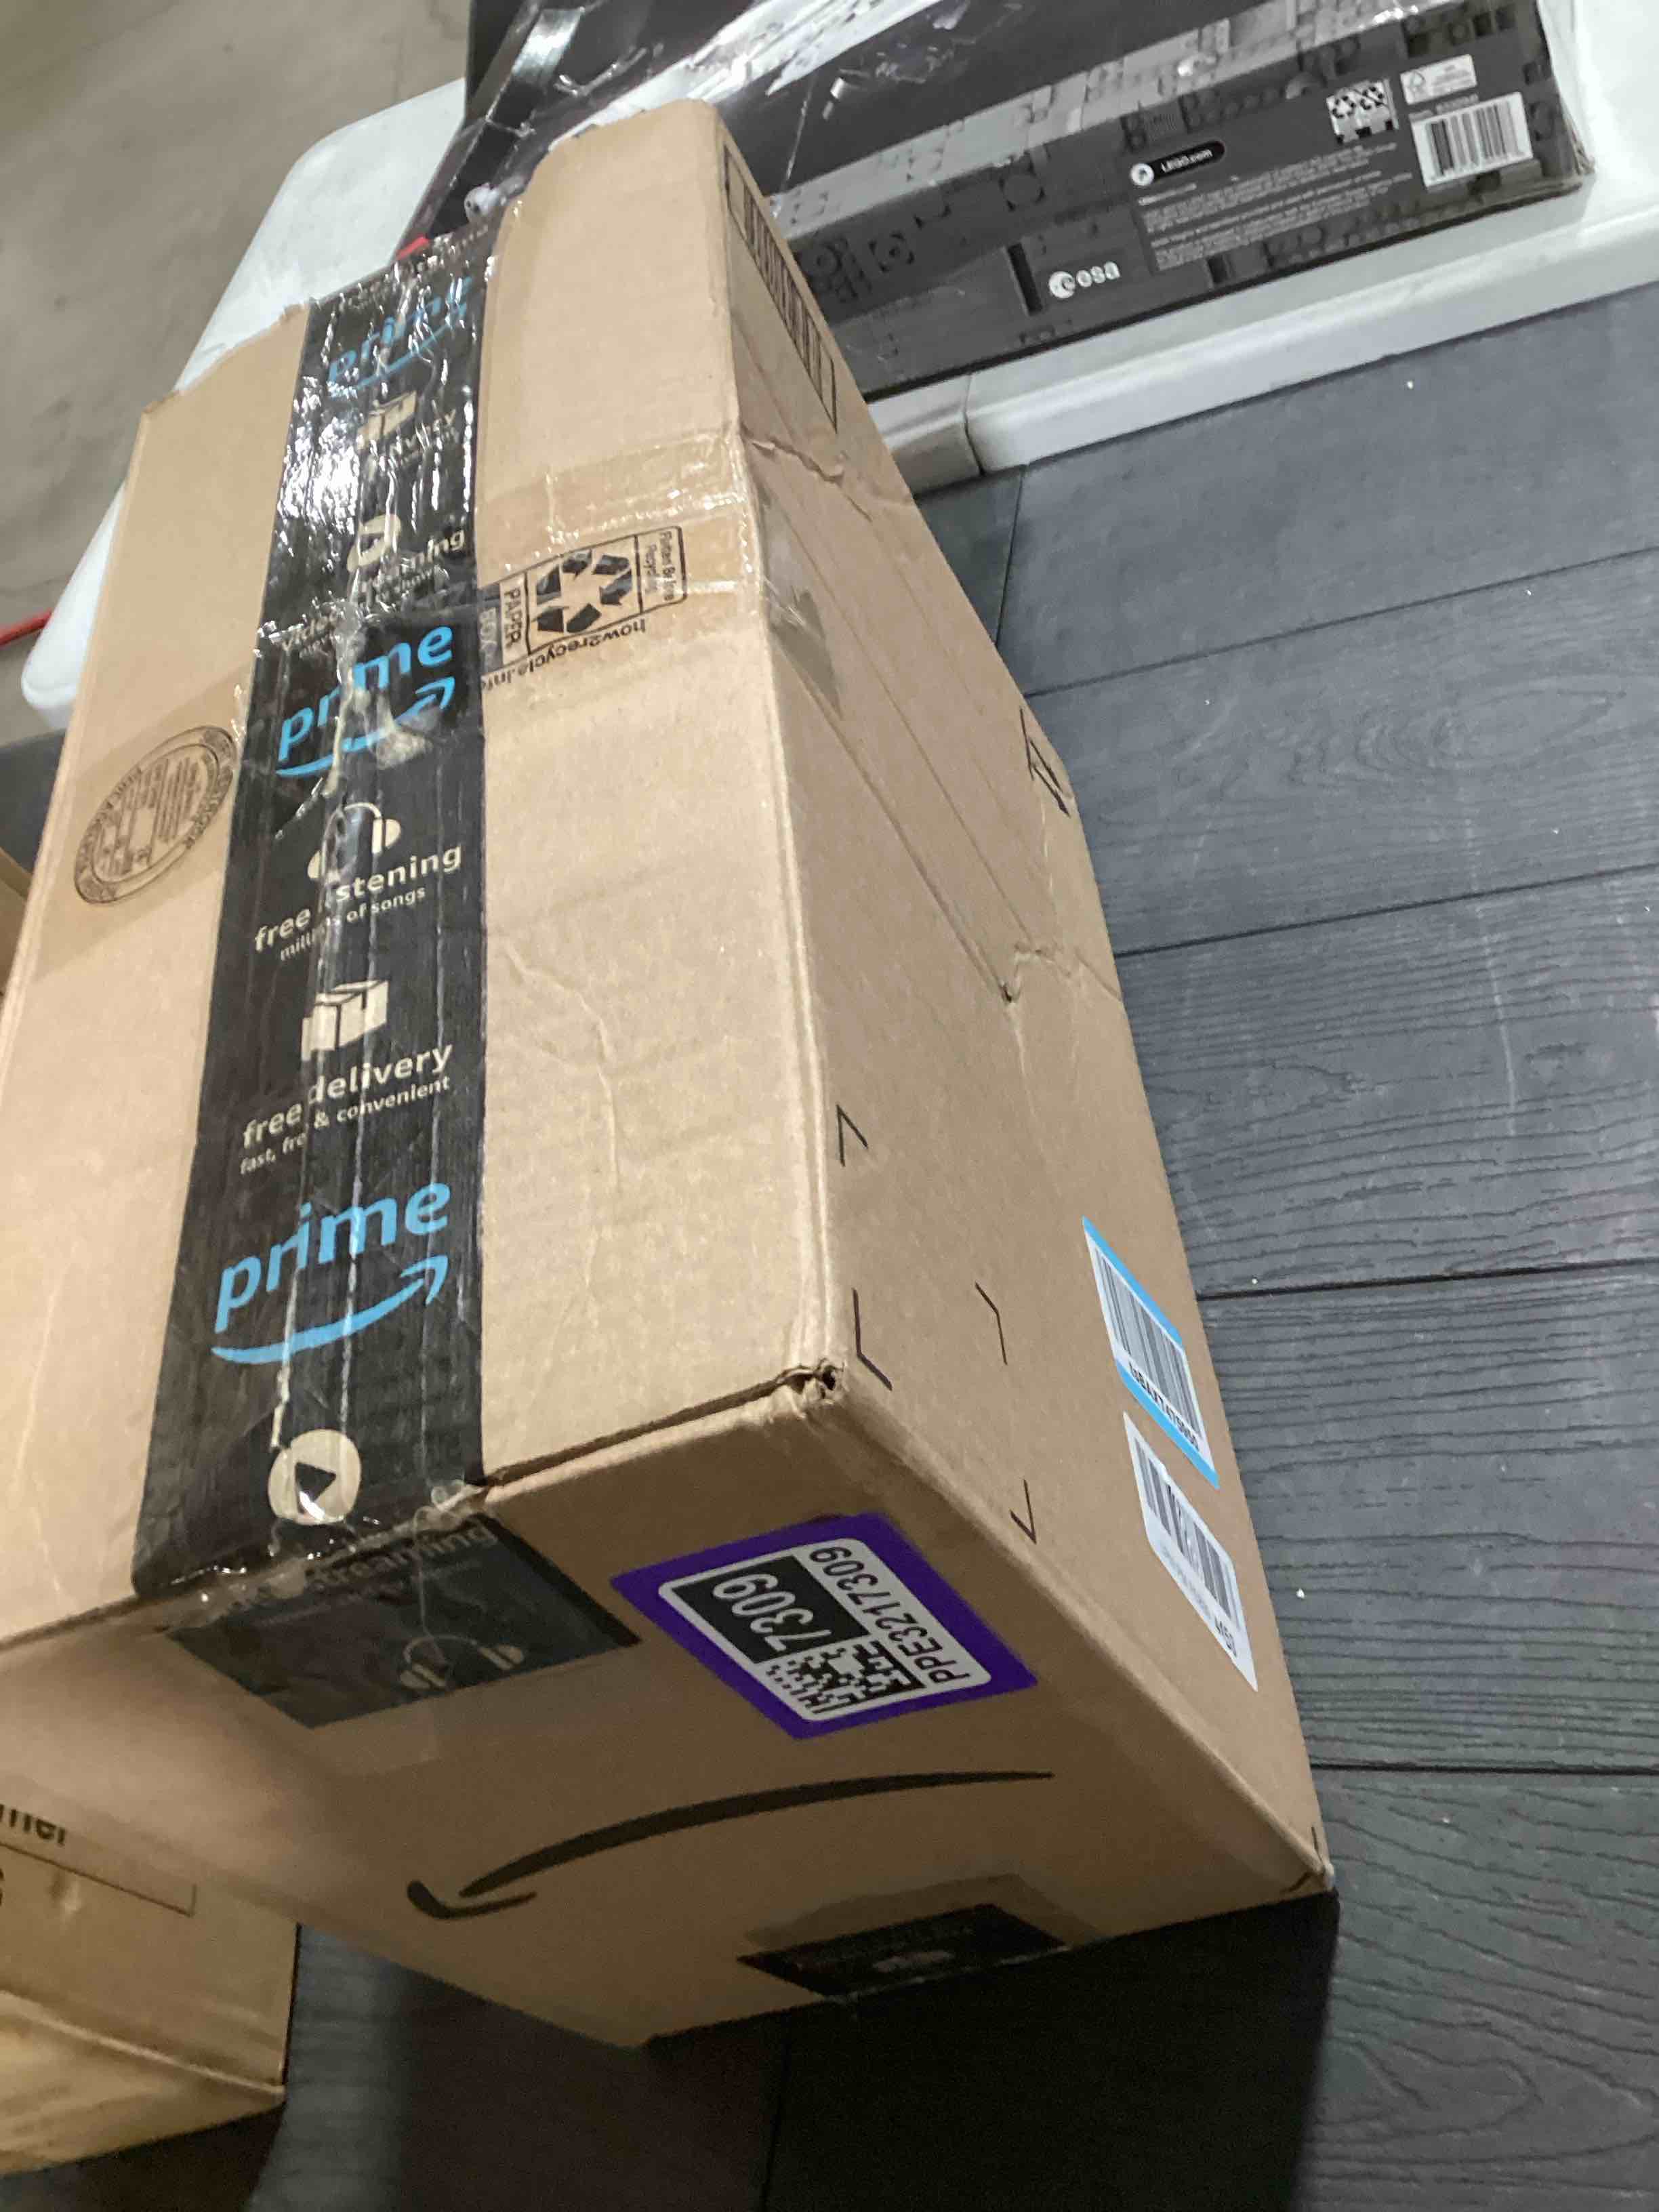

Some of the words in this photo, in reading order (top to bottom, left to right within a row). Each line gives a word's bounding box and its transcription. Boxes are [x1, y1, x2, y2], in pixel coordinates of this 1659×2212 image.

[277, 624, 453, 762] prme
[254, 907, 311, 952] free
[346, 903, 367, 923] of
[371, 886, 426, 915] songs
[243, 1103, 302, 1149] free
[308, 1044, 453, 1104] delivery
[337, 1076, 451, 1123] convenient
[213, 1181, 452, 1335] prime
[712, 1573, 832, 1652] 7309
[809, 1546, 971, 1685] PPE3217309
